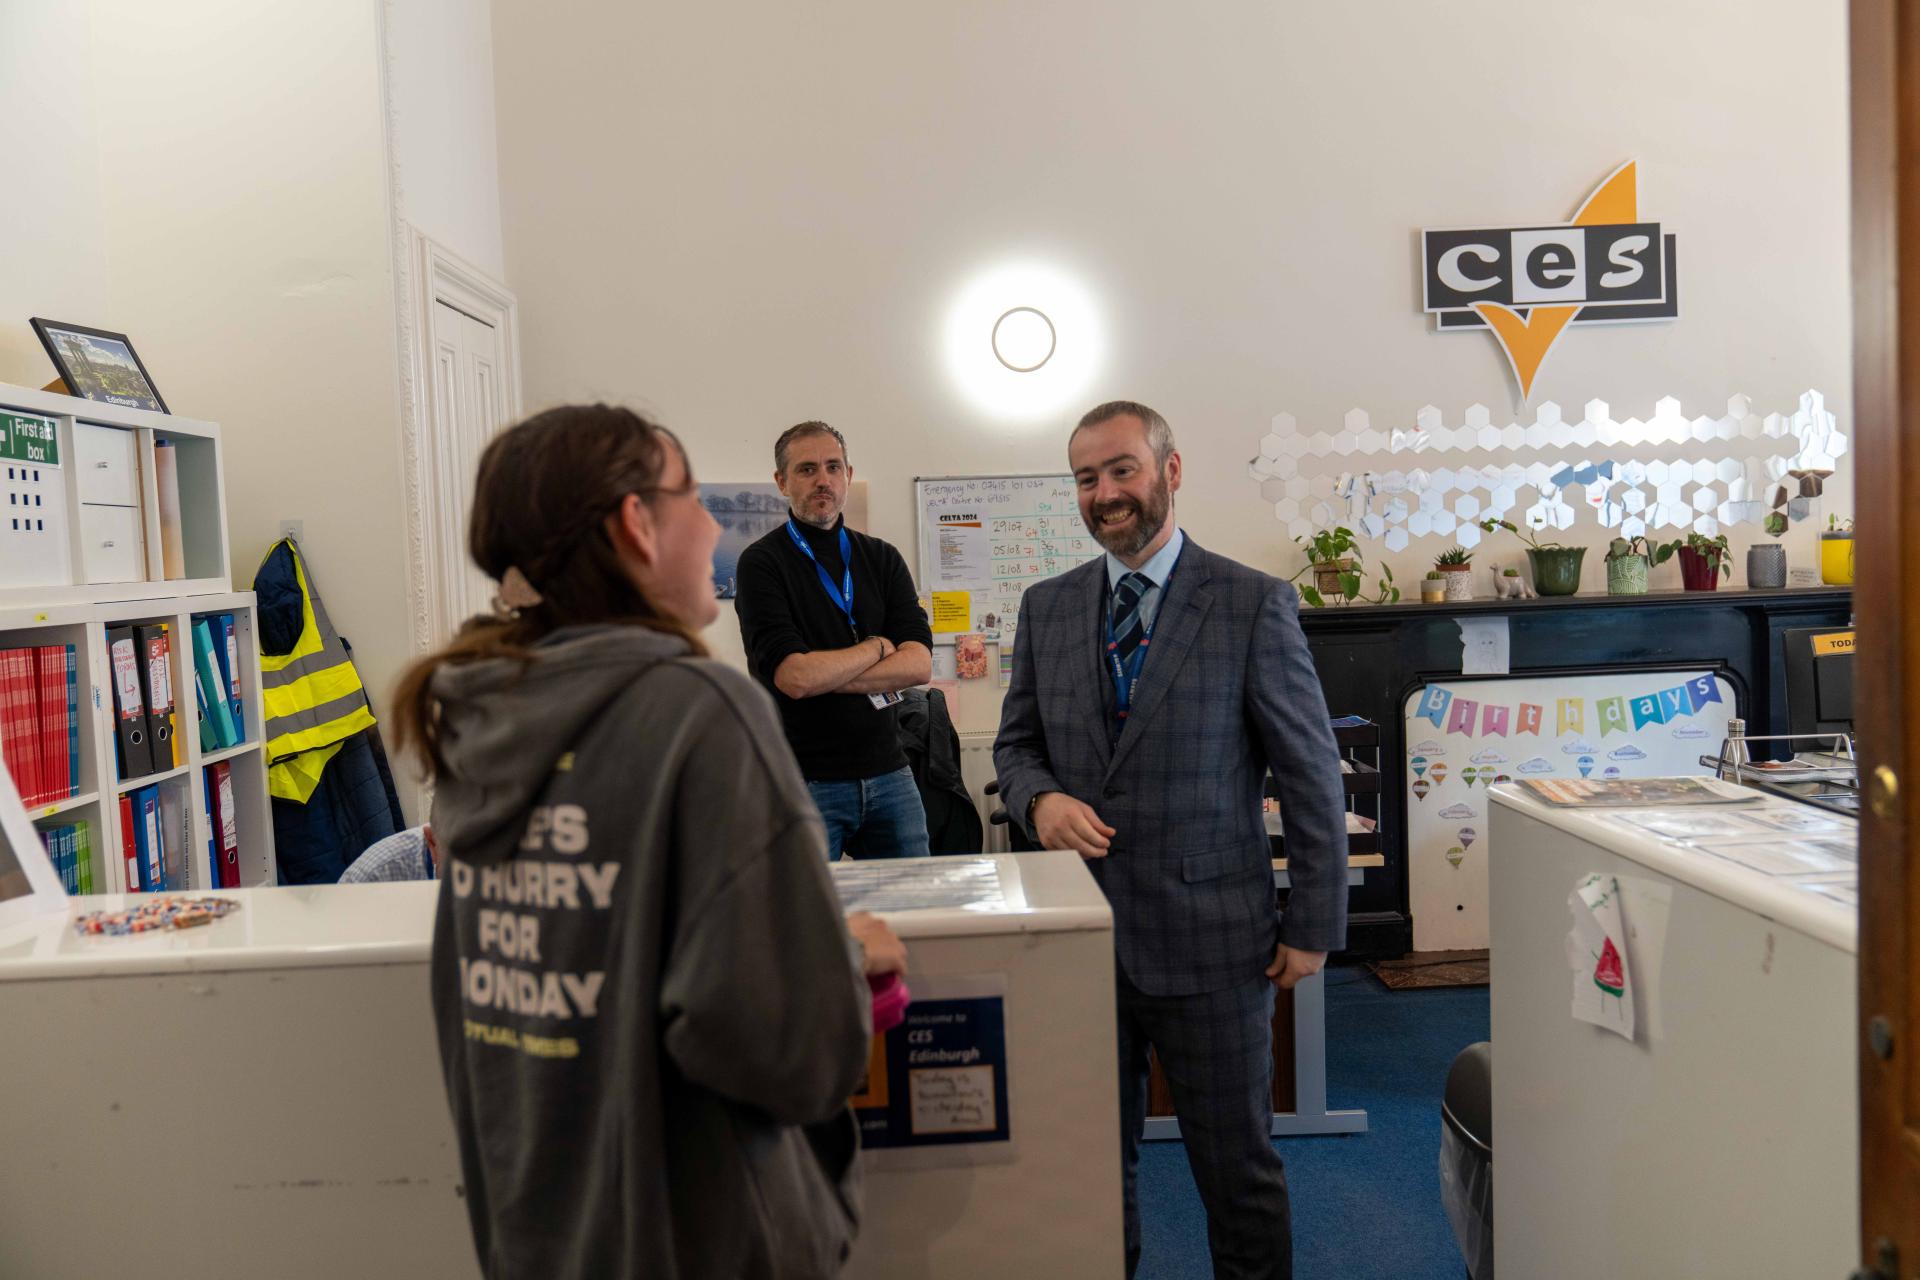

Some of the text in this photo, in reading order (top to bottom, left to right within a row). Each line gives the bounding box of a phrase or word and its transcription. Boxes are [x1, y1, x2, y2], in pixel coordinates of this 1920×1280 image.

[1437, 234, 1650, 293] ces
[15, 418, 38, 439] First
[27, 442, 45, 461] box
[939, 513, 978, 522] CELTA 2024
[480, 860, 621, 910] HURRY
[476, 907, 543, 964] FOR
[907, 1029, 934, 1044] CES
[908, 1046, 981, 1064] Edinburgh
